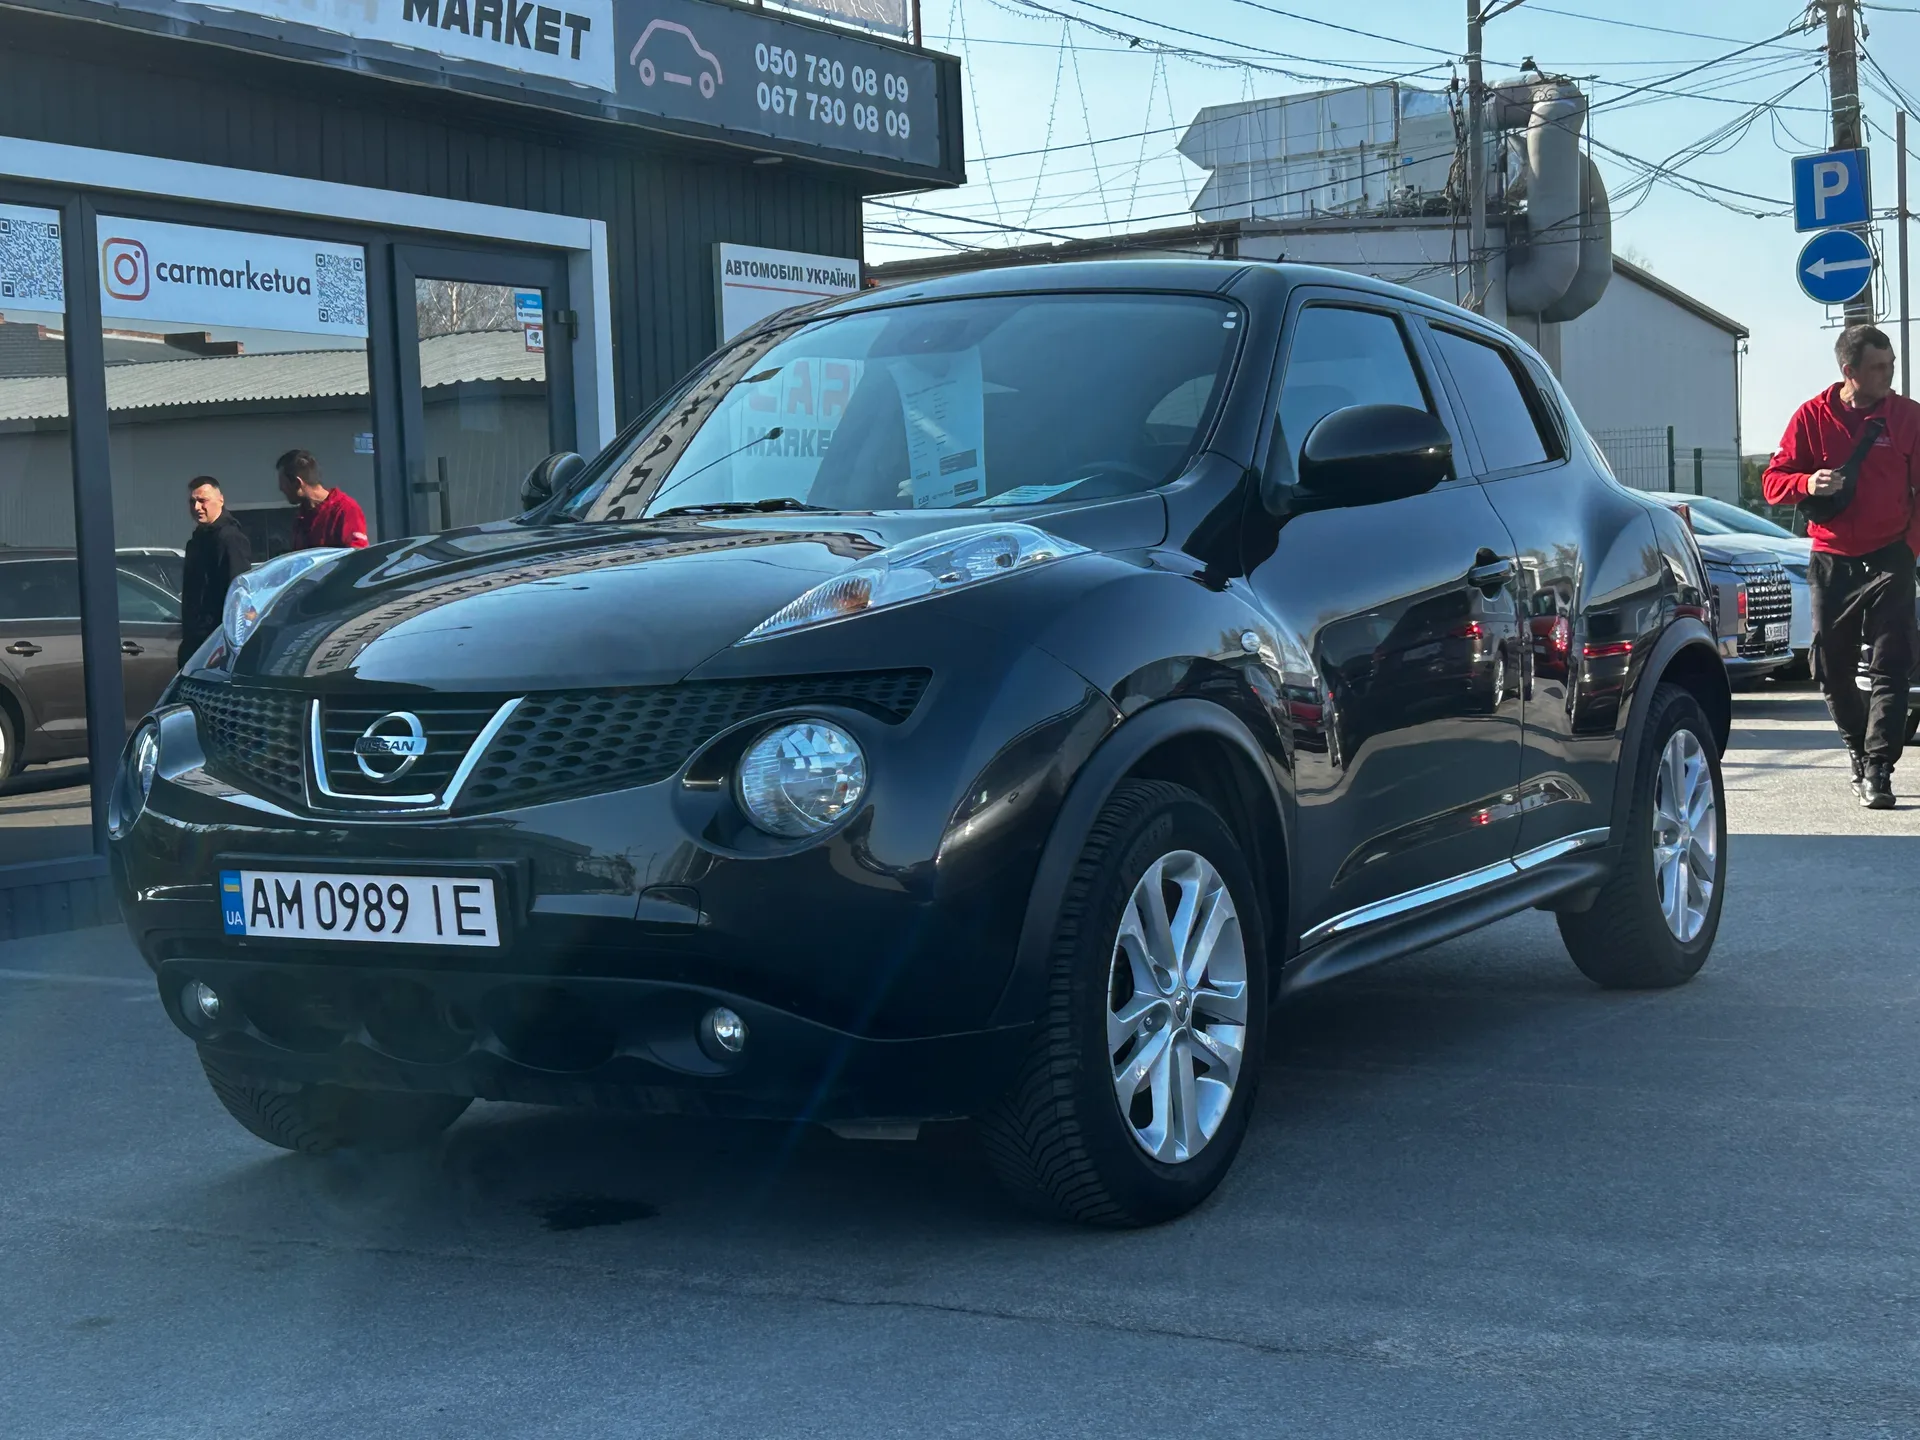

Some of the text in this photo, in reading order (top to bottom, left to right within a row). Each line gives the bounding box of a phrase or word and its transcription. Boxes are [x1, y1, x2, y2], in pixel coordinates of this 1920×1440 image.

[403, 0, 591, 60] MARKET
[755, 43, 909, 103] 050 730 08 09
[757, 82, 910, 139] 067 730 08 09
[1813, 161, 1849, 220] P
[156, 260, 311, 295] carmarketua
[725, 259, 856, 289] АВТОМОБІЛІ УКРАЇНИ
[357, 740, 415, 752] NISSAN
[226, 910, 243, 925] UA
[250, 878, 487, 936] AM 0989 IE
